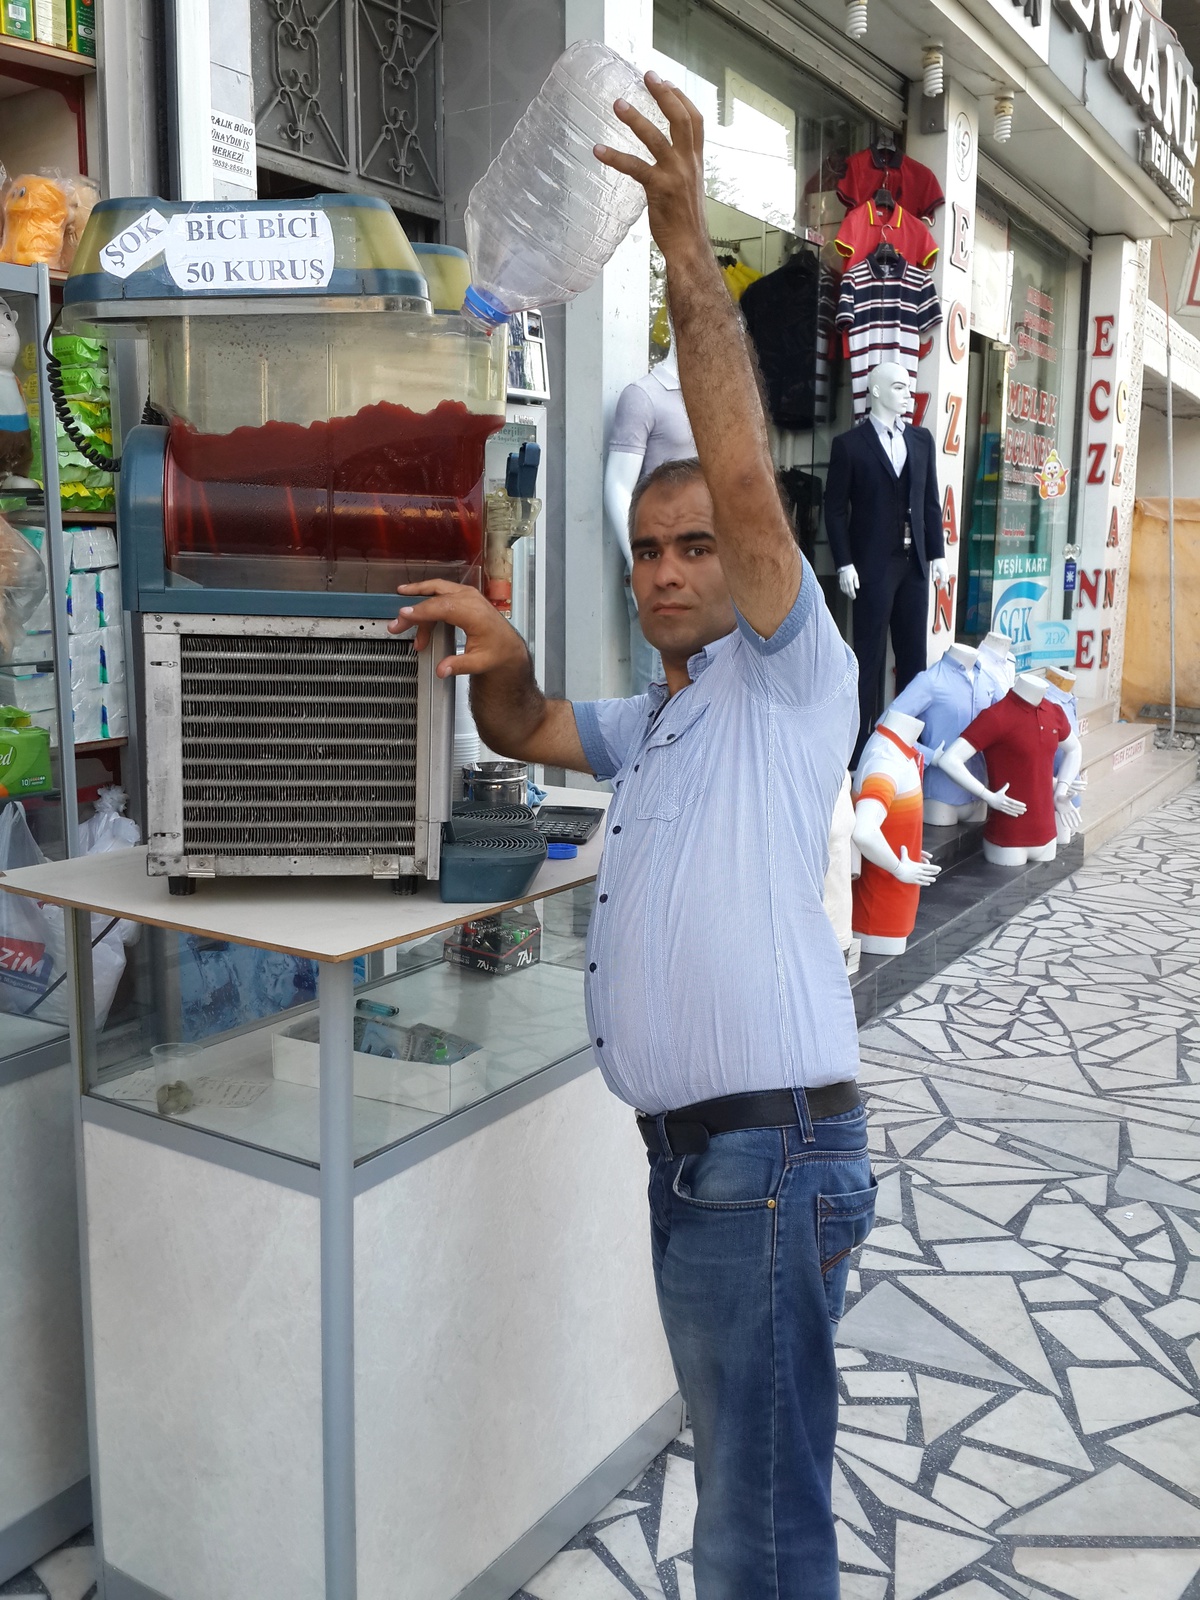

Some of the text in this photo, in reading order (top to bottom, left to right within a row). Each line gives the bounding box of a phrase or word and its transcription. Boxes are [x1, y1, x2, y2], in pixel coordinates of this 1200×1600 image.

[234, 123, 254, 137] BÜRO
[212, 144, 245, 162] MERKEZİ
[105, 214, 164, 268] ŞOK
[186, 211, 320, 242] BİCİ BİCİ
[187, 258, 325, 286] 50 KURUŞ
[1006, 379, 1059, 428] MELEK
[997, 555, 1048, 578] YEŞİL KART
[1000, 606, 1032, 645] SGK
